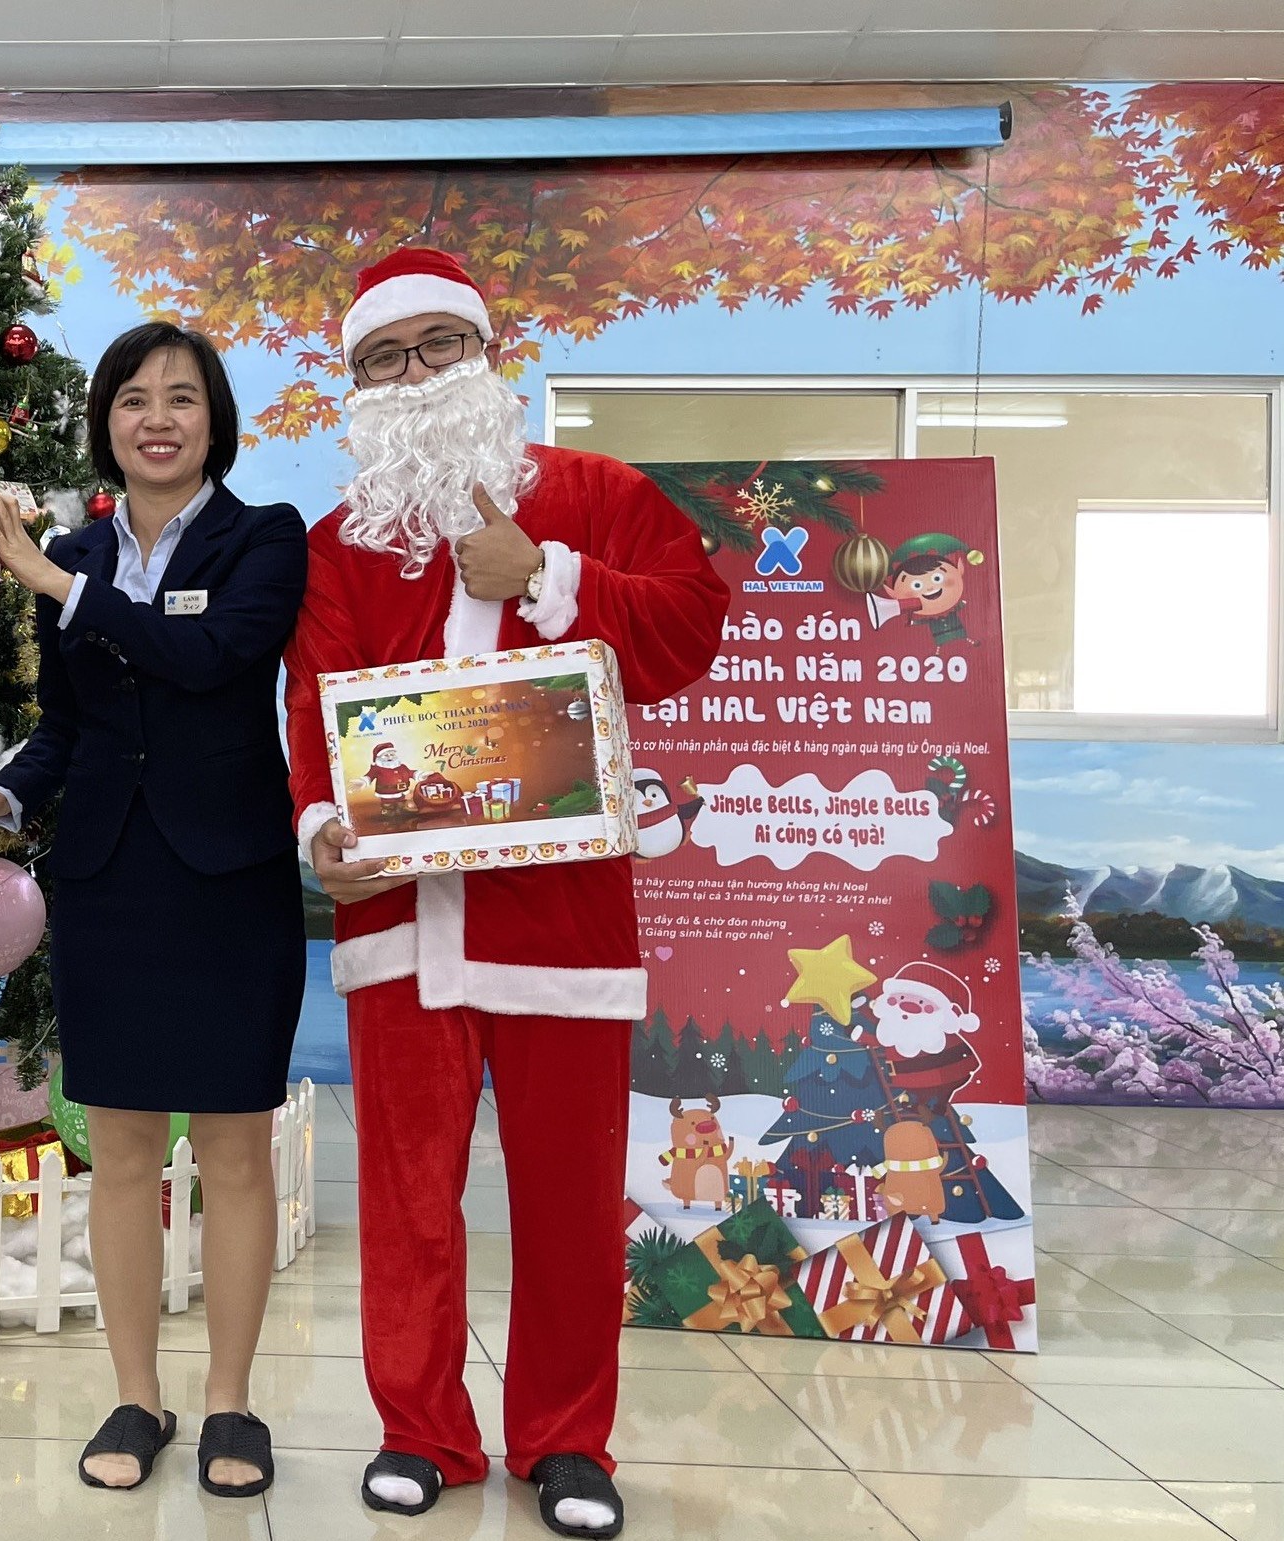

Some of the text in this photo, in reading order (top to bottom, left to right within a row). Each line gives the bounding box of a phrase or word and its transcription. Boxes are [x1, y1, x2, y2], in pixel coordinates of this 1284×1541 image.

[744, 582, 823, 591] HAL VIETNAM
[722, 610, 860, 640] hào đón
[710, 652, 967, 682] Sinh Năm 2020
[637, 692, 931, 729] tại HAL Việt Nam
[436, 718, 489, 732] NOEL 2020
[424, 742, 464, 759] Merry
[643, 741, 656, 750] cơ
[658, 739, 674, 754] hội
[677, 739, 700, 754] nhận
[703, 737, 728, 754] phần
[751, 740, 769, 755] đặc
[773, 740, 791, 755] biệt
[794, 740, 801, 752] &
[804, 740, 829, 756] hàng
[832, 740, 856, 756] ngàn
[882, 742, 904, 756] tặng
[921, 739, 942, 756] Ông
[964, 742, 990, 755] Noel.
[448, 753, 507, 769] Christmas
[710, 795, 930, 818] Jingle Bells, Jingle Bells
[755, 822, 885, 847] Ai cũng có quà!
[633, 878, 642, 886] ta
[646, 878, 665, 888] hãy
[668, 878, 694, 889] cùng
[697, 879, 724, 887] nhau
[727, 879, 743, 890] tận
[786, 881, 820, 892] không
[843, 882, 868, 891] Noel
[643, 890, 663, 900] Việt
[666, 891, 689, 899] Nam
[693, 892, 705, 901] tại
[725, 892, 730, 900] 3
[798, 894, 826, 903] 18/12
[836, 895, 864, 904] 24/12
[693, 917, 701, 925] &
[727, 917, 748, 926] đón
[646, 928, 677, 939] Giáng
[680, 929, 702, 937] sinh
[705, 928, 722, 938] bất
